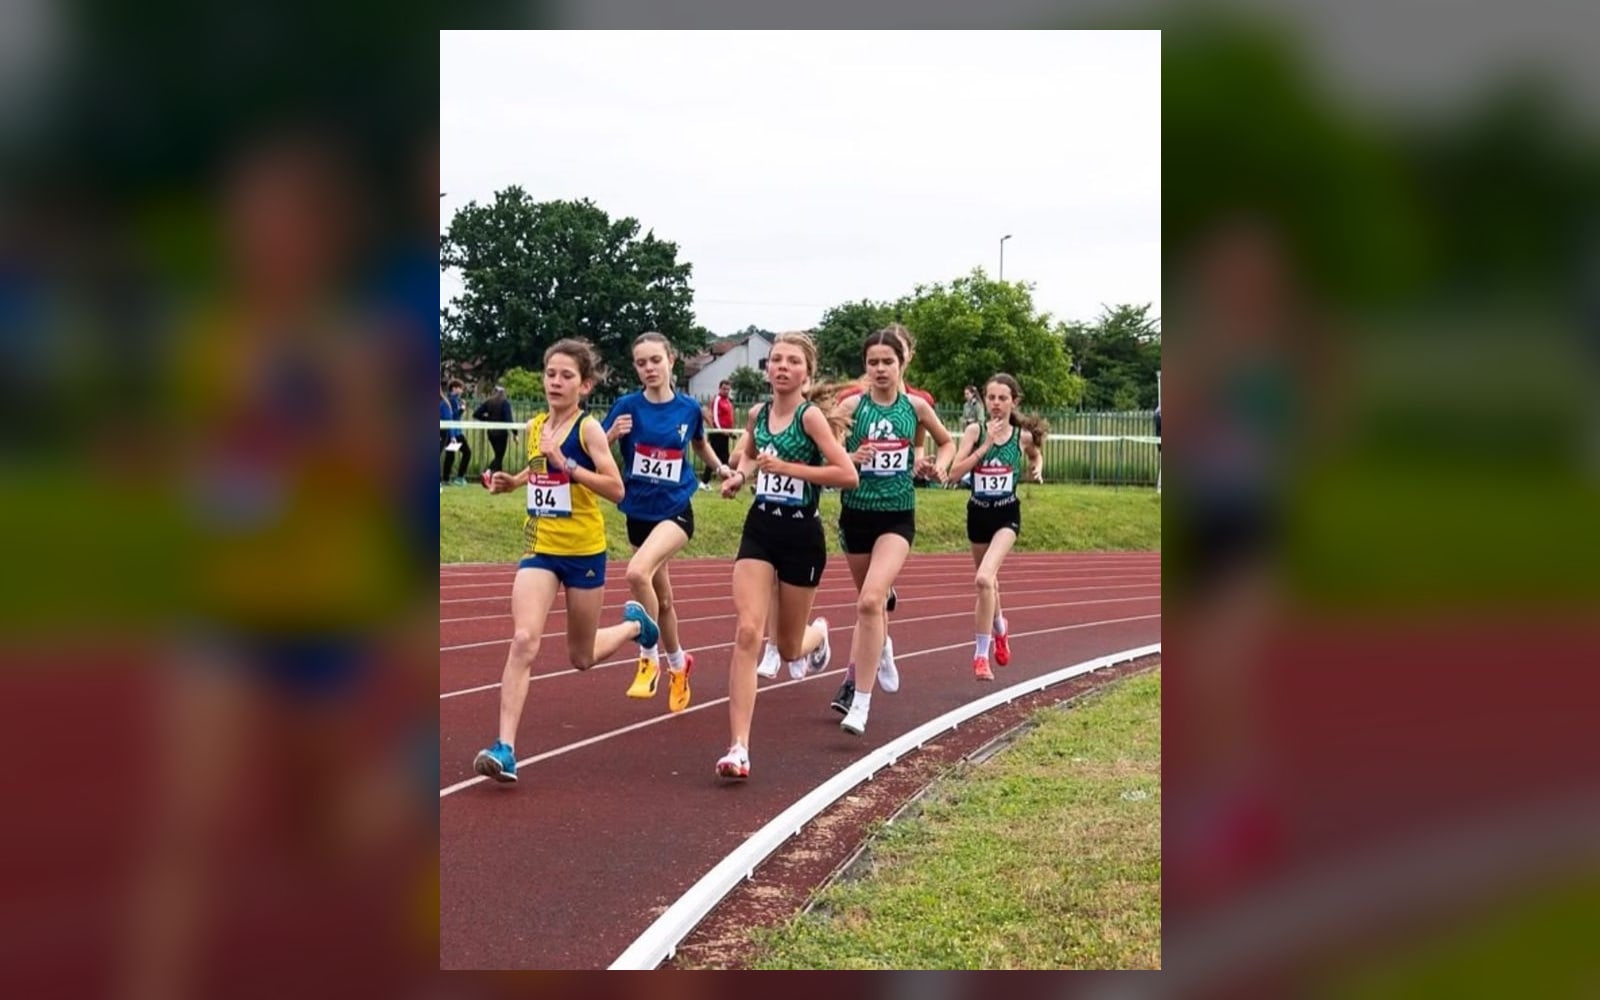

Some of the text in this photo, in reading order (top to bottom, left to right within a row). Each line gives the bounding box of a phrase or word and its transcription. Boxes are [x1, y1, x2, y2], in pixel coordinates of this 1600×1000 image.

[640, 458, 673, 478] 341
[872, 452, 903, 469] 132
[763, 474, 796, 495] 134
[981, 476, 1008, 490] 137
[534, 488, 556, 508] 84
[993, 495, 1017, 508] NIKE
